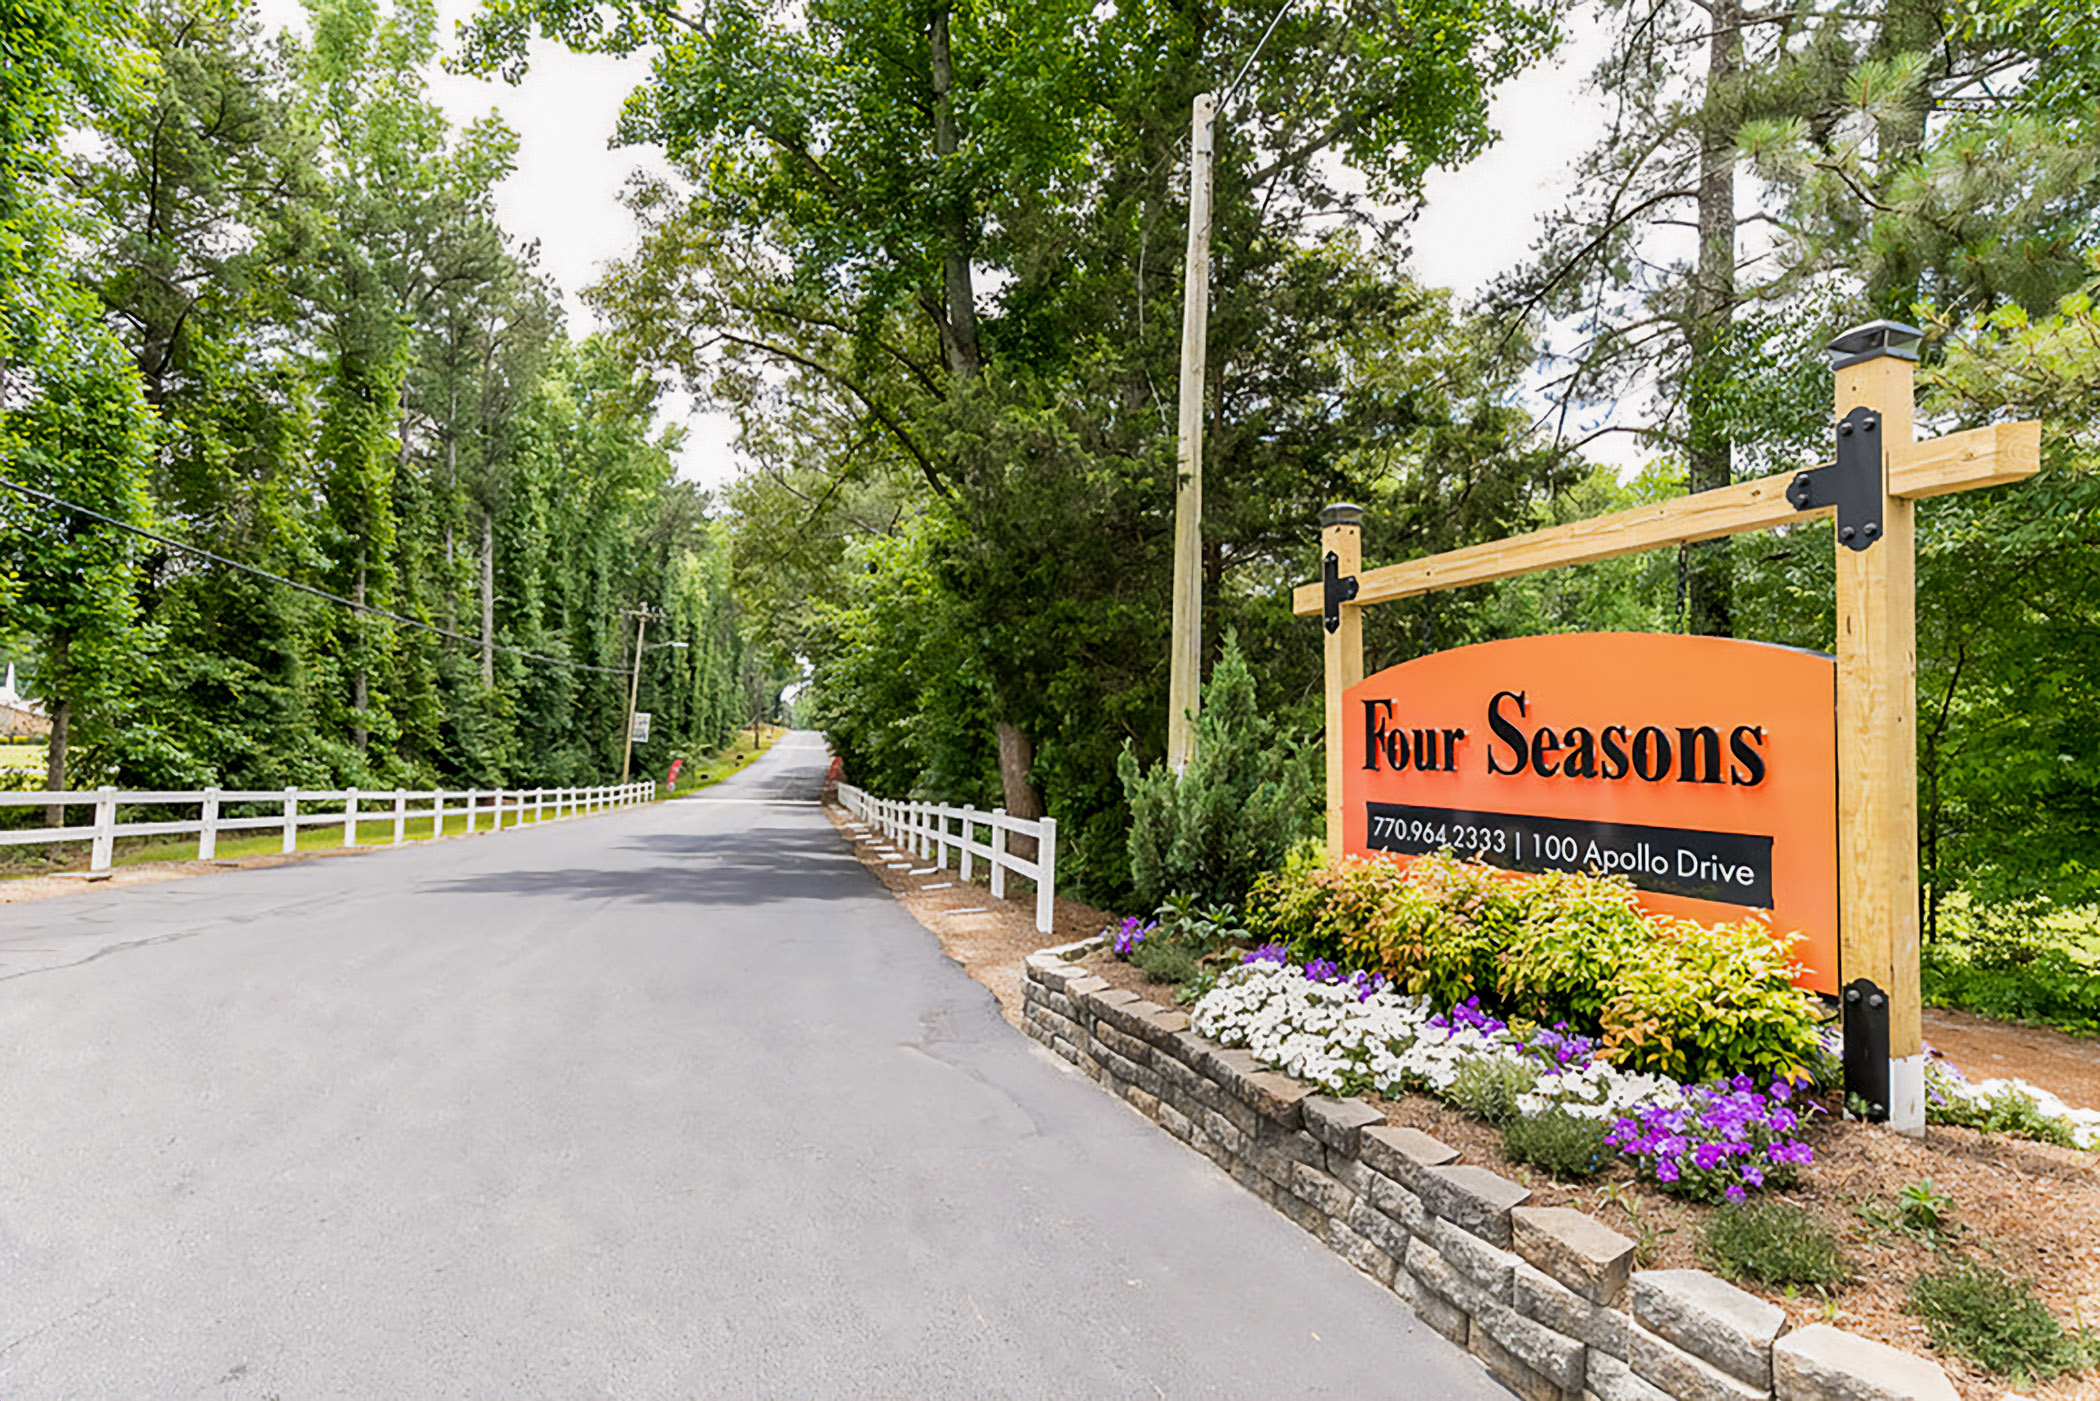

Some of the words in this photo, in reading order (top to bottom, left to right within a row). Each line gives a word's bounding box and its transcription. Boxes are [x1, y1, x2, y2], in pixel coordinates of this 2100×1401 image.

[1361, 698, 1465, 771] Four
[1487, 690, 1767, 786] Seasons
[1532, 833, 1578, 862] 100
[1583, 840, 1669, 876] Apollo
[1677, 849, 1755, 887] Drive
